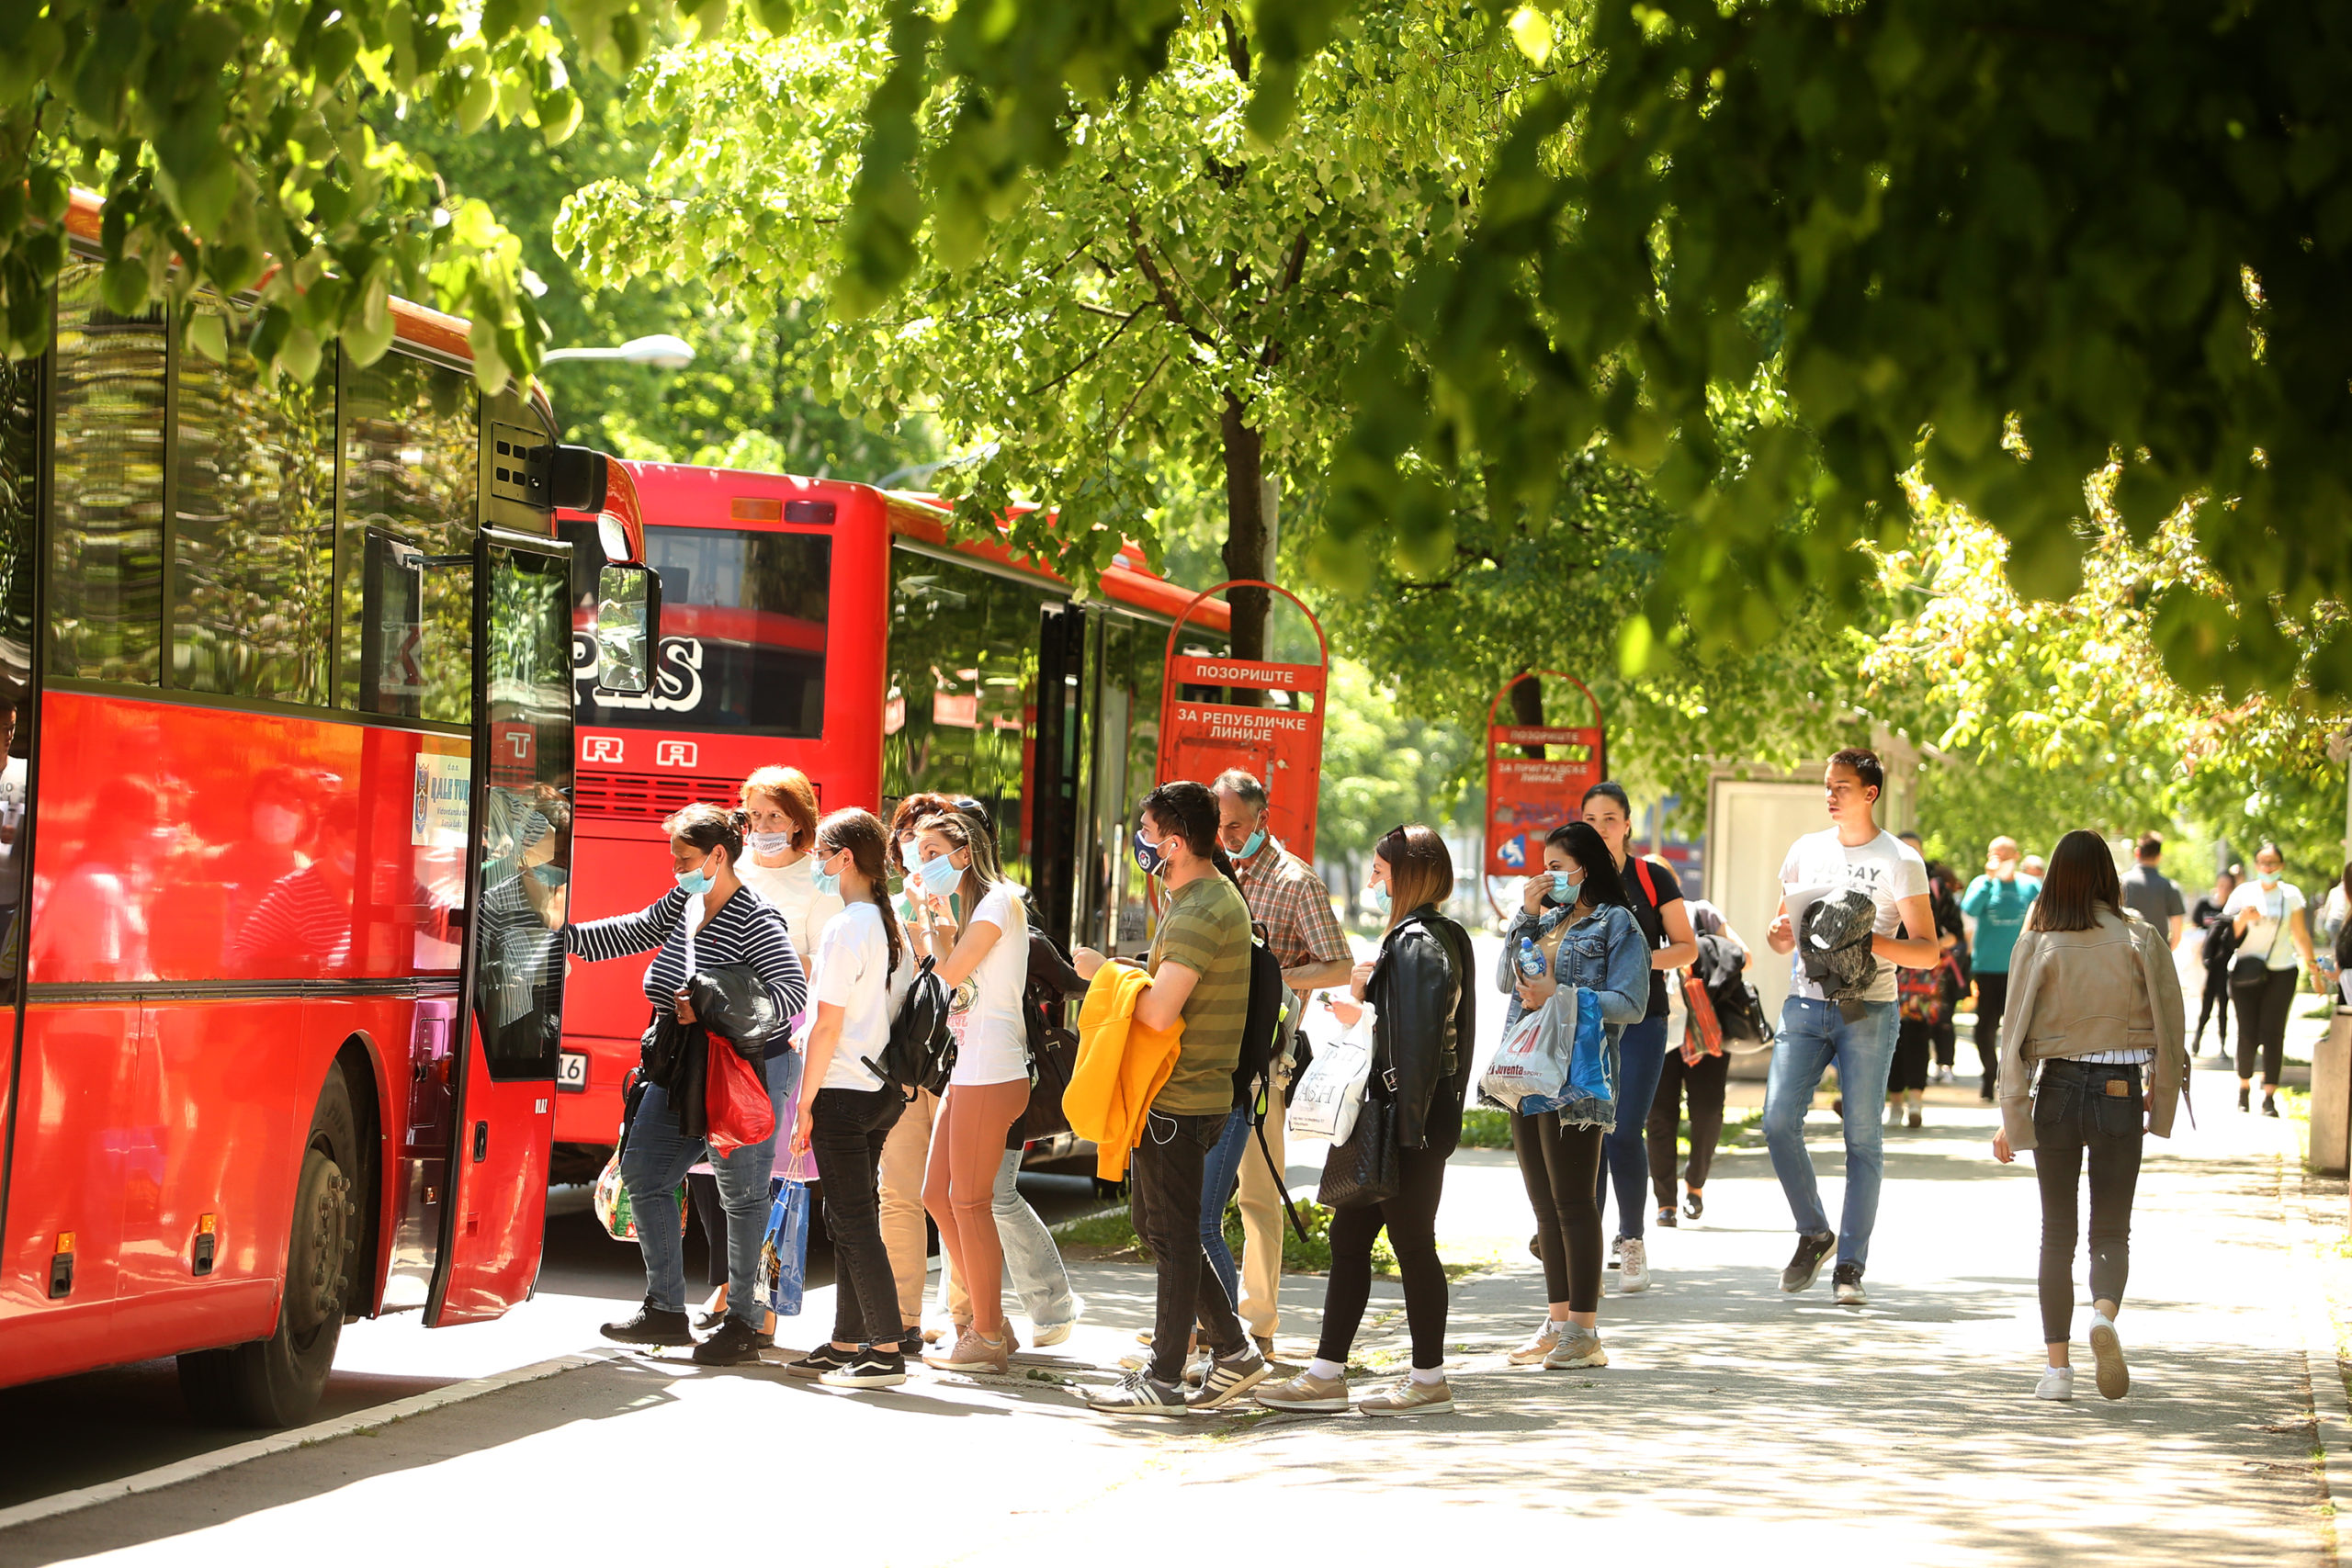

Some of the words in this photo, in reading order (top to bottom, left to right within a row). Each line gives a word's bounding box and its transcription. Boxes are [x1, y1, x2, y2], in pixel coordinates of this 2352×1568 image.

[1196, 665, 1294, 683] ПОЗОРИШТЕ
[1178, 708, 1197, 721] ЗА
[1203, 712, 1306, 730] РЕПУБЛИЧКЕ
[1210, 726, 1272, 741] ЛИНИЈЕ
[1495, 1065, 1523, 1076] Juventa
